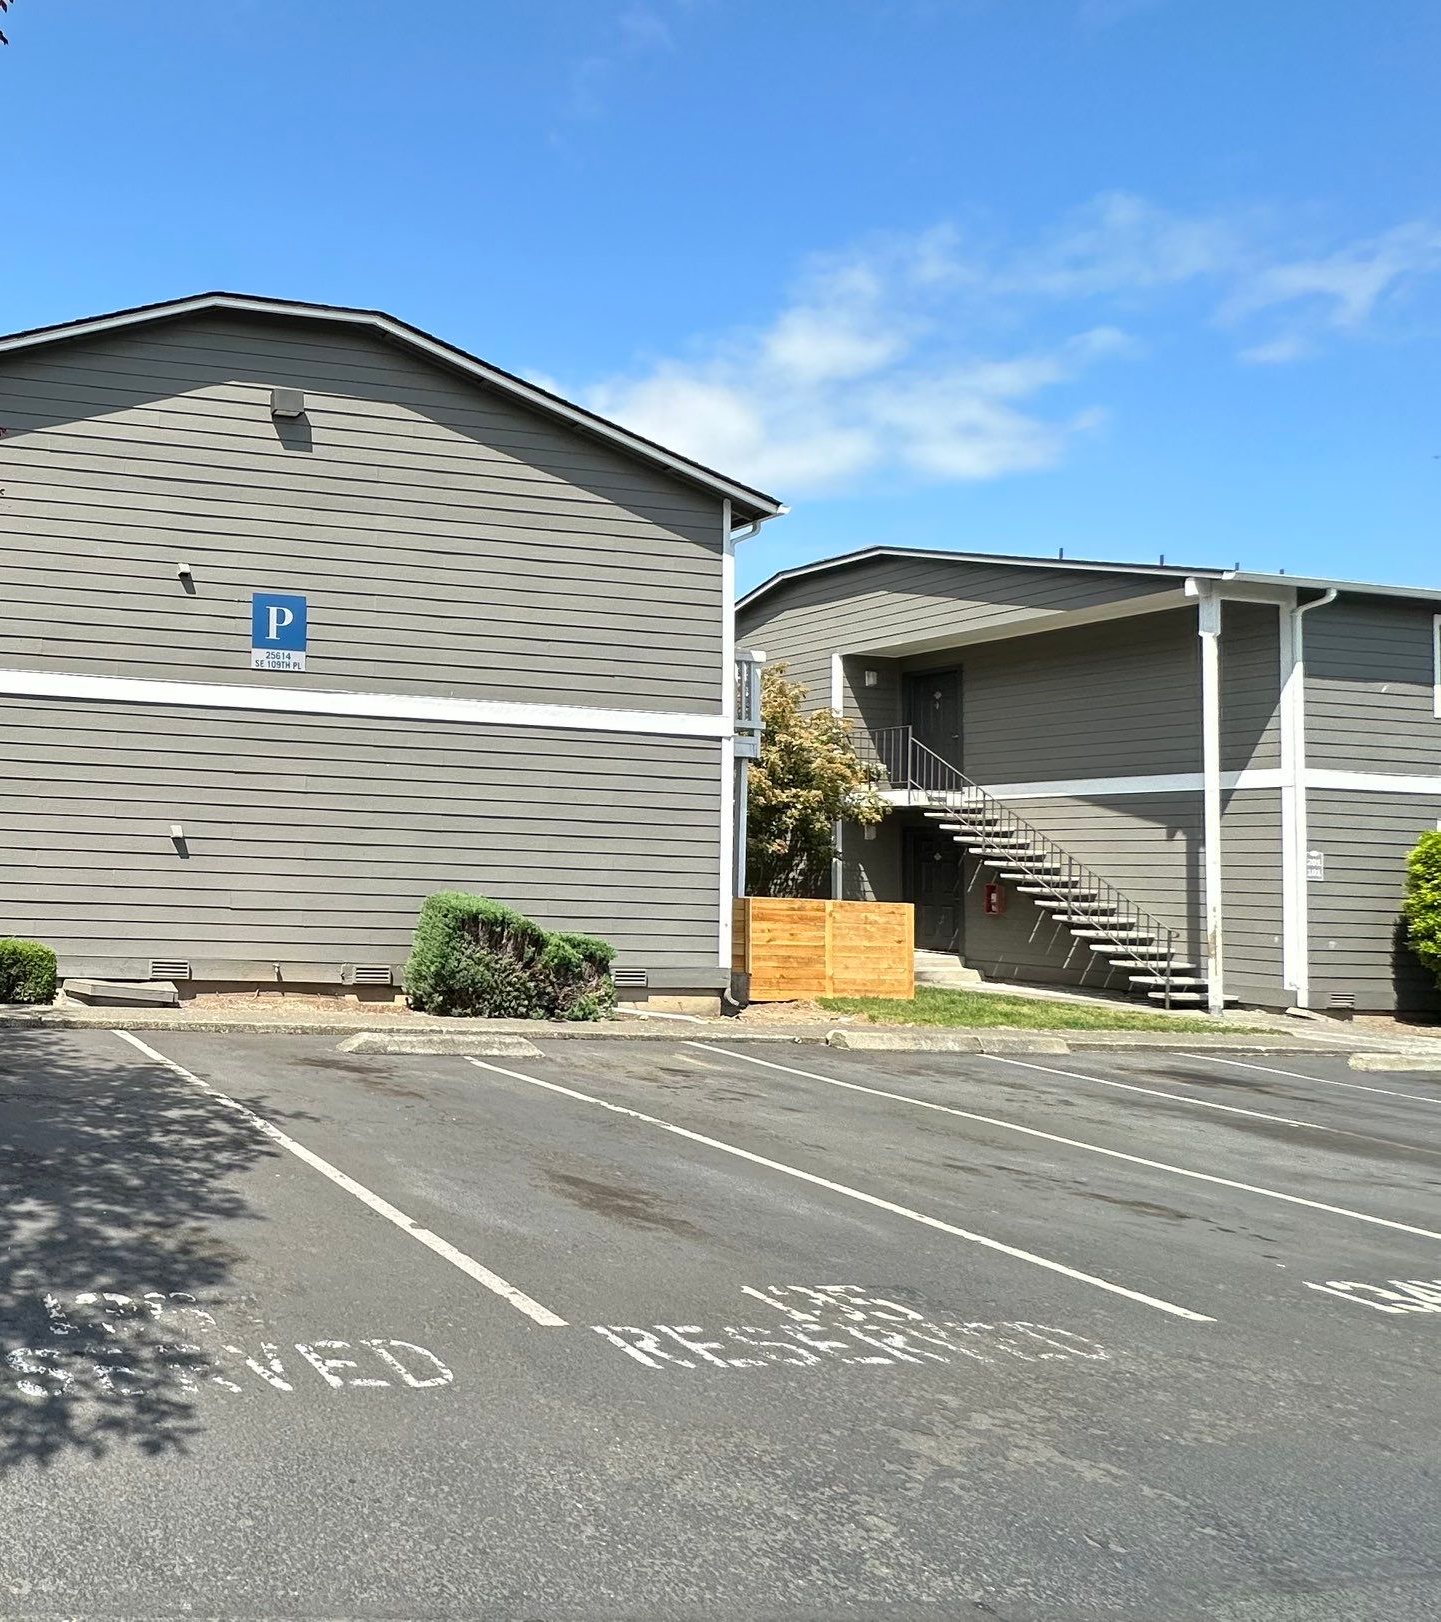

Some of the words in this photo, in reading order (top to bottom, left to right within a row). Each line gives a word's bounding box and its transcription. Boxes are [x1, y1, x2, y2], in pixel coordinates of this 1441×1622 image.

[265, 605, 294, 640] P
[255, 659, 264, 668] SE
[267, 660, 291, 669] 109TH
[292, 661, 302, 670] PL
[265, 651, 291, 660] 25614
[589, 1319, 1113, 1370] RESERVED
